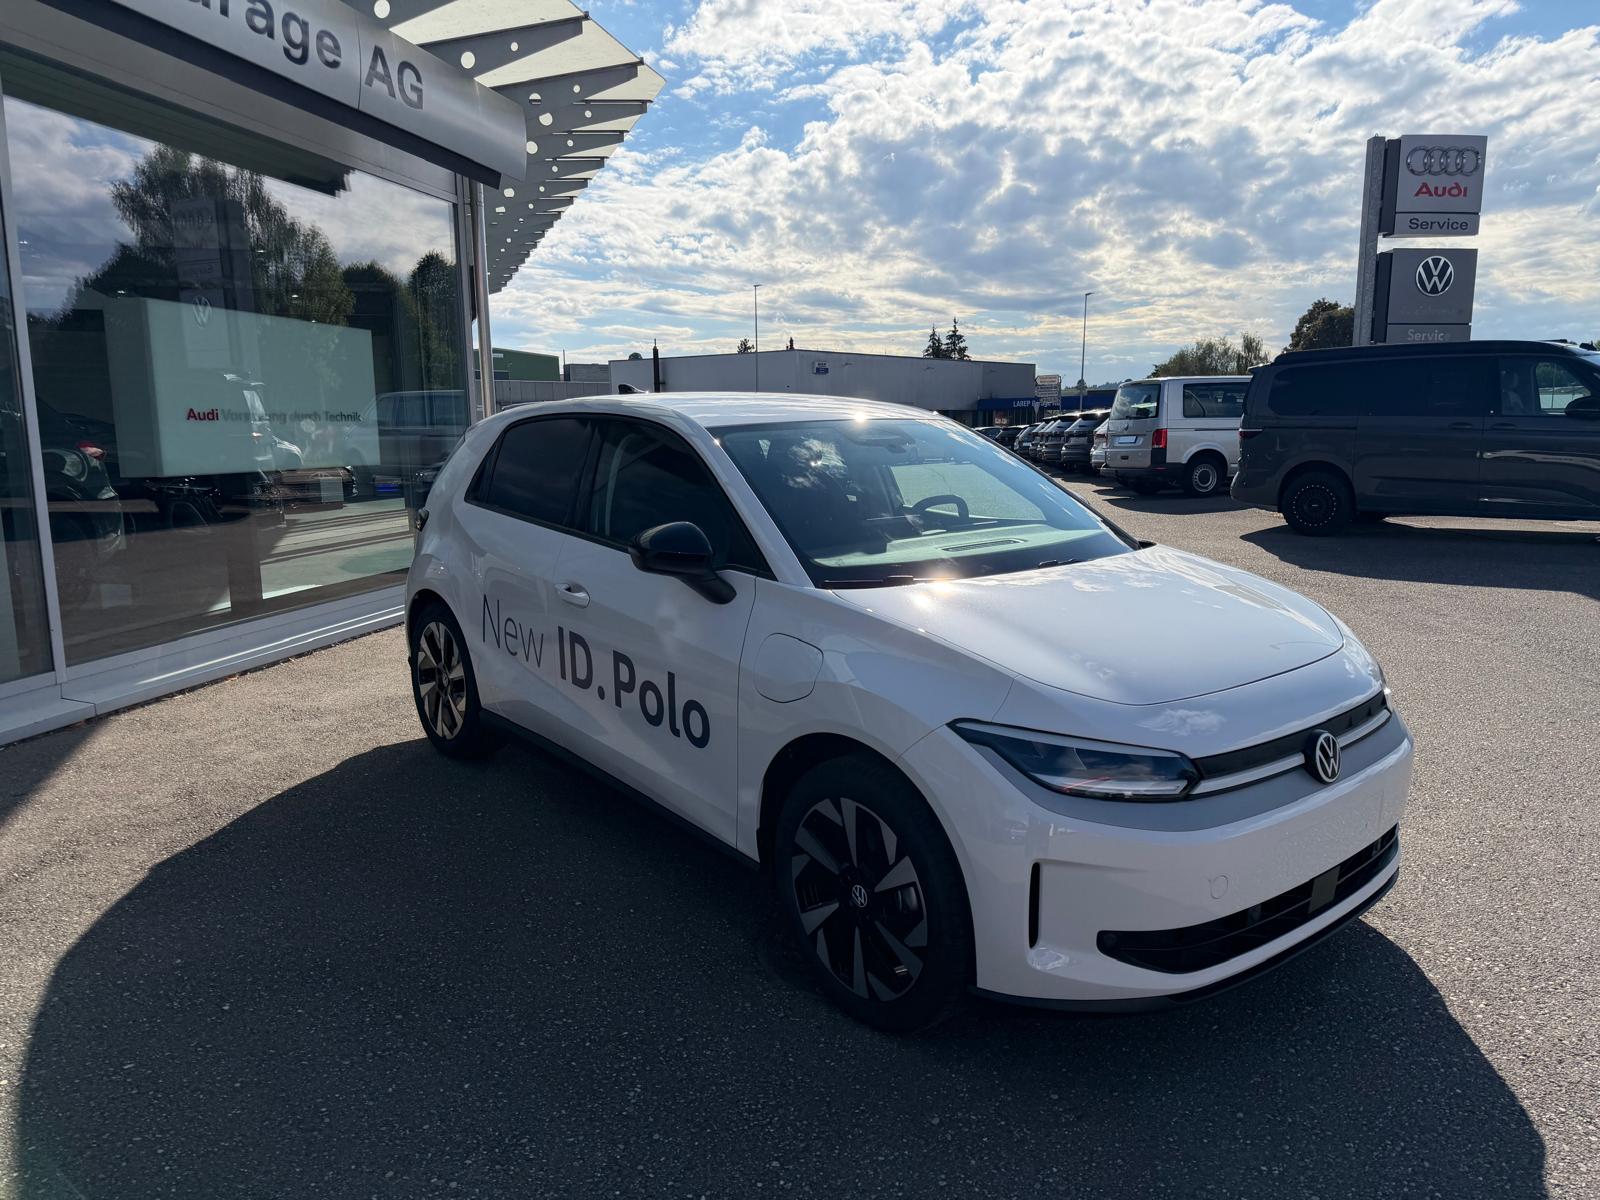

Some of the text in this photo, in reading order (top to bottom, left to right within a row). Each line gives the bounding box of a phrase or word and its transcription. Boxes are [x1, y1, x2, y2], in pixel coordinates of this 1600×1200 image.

[364, 45, 424, 110] AG
[1414, 182, 1468, 198] Audi
[1408, 218, 1469, 231] Service
[1408, 329, 1447, 341] Servic
[186, 408, 219, 421] Audi
[324, 411, 362, 422] Technik
[483, 594, 544, 668] New
